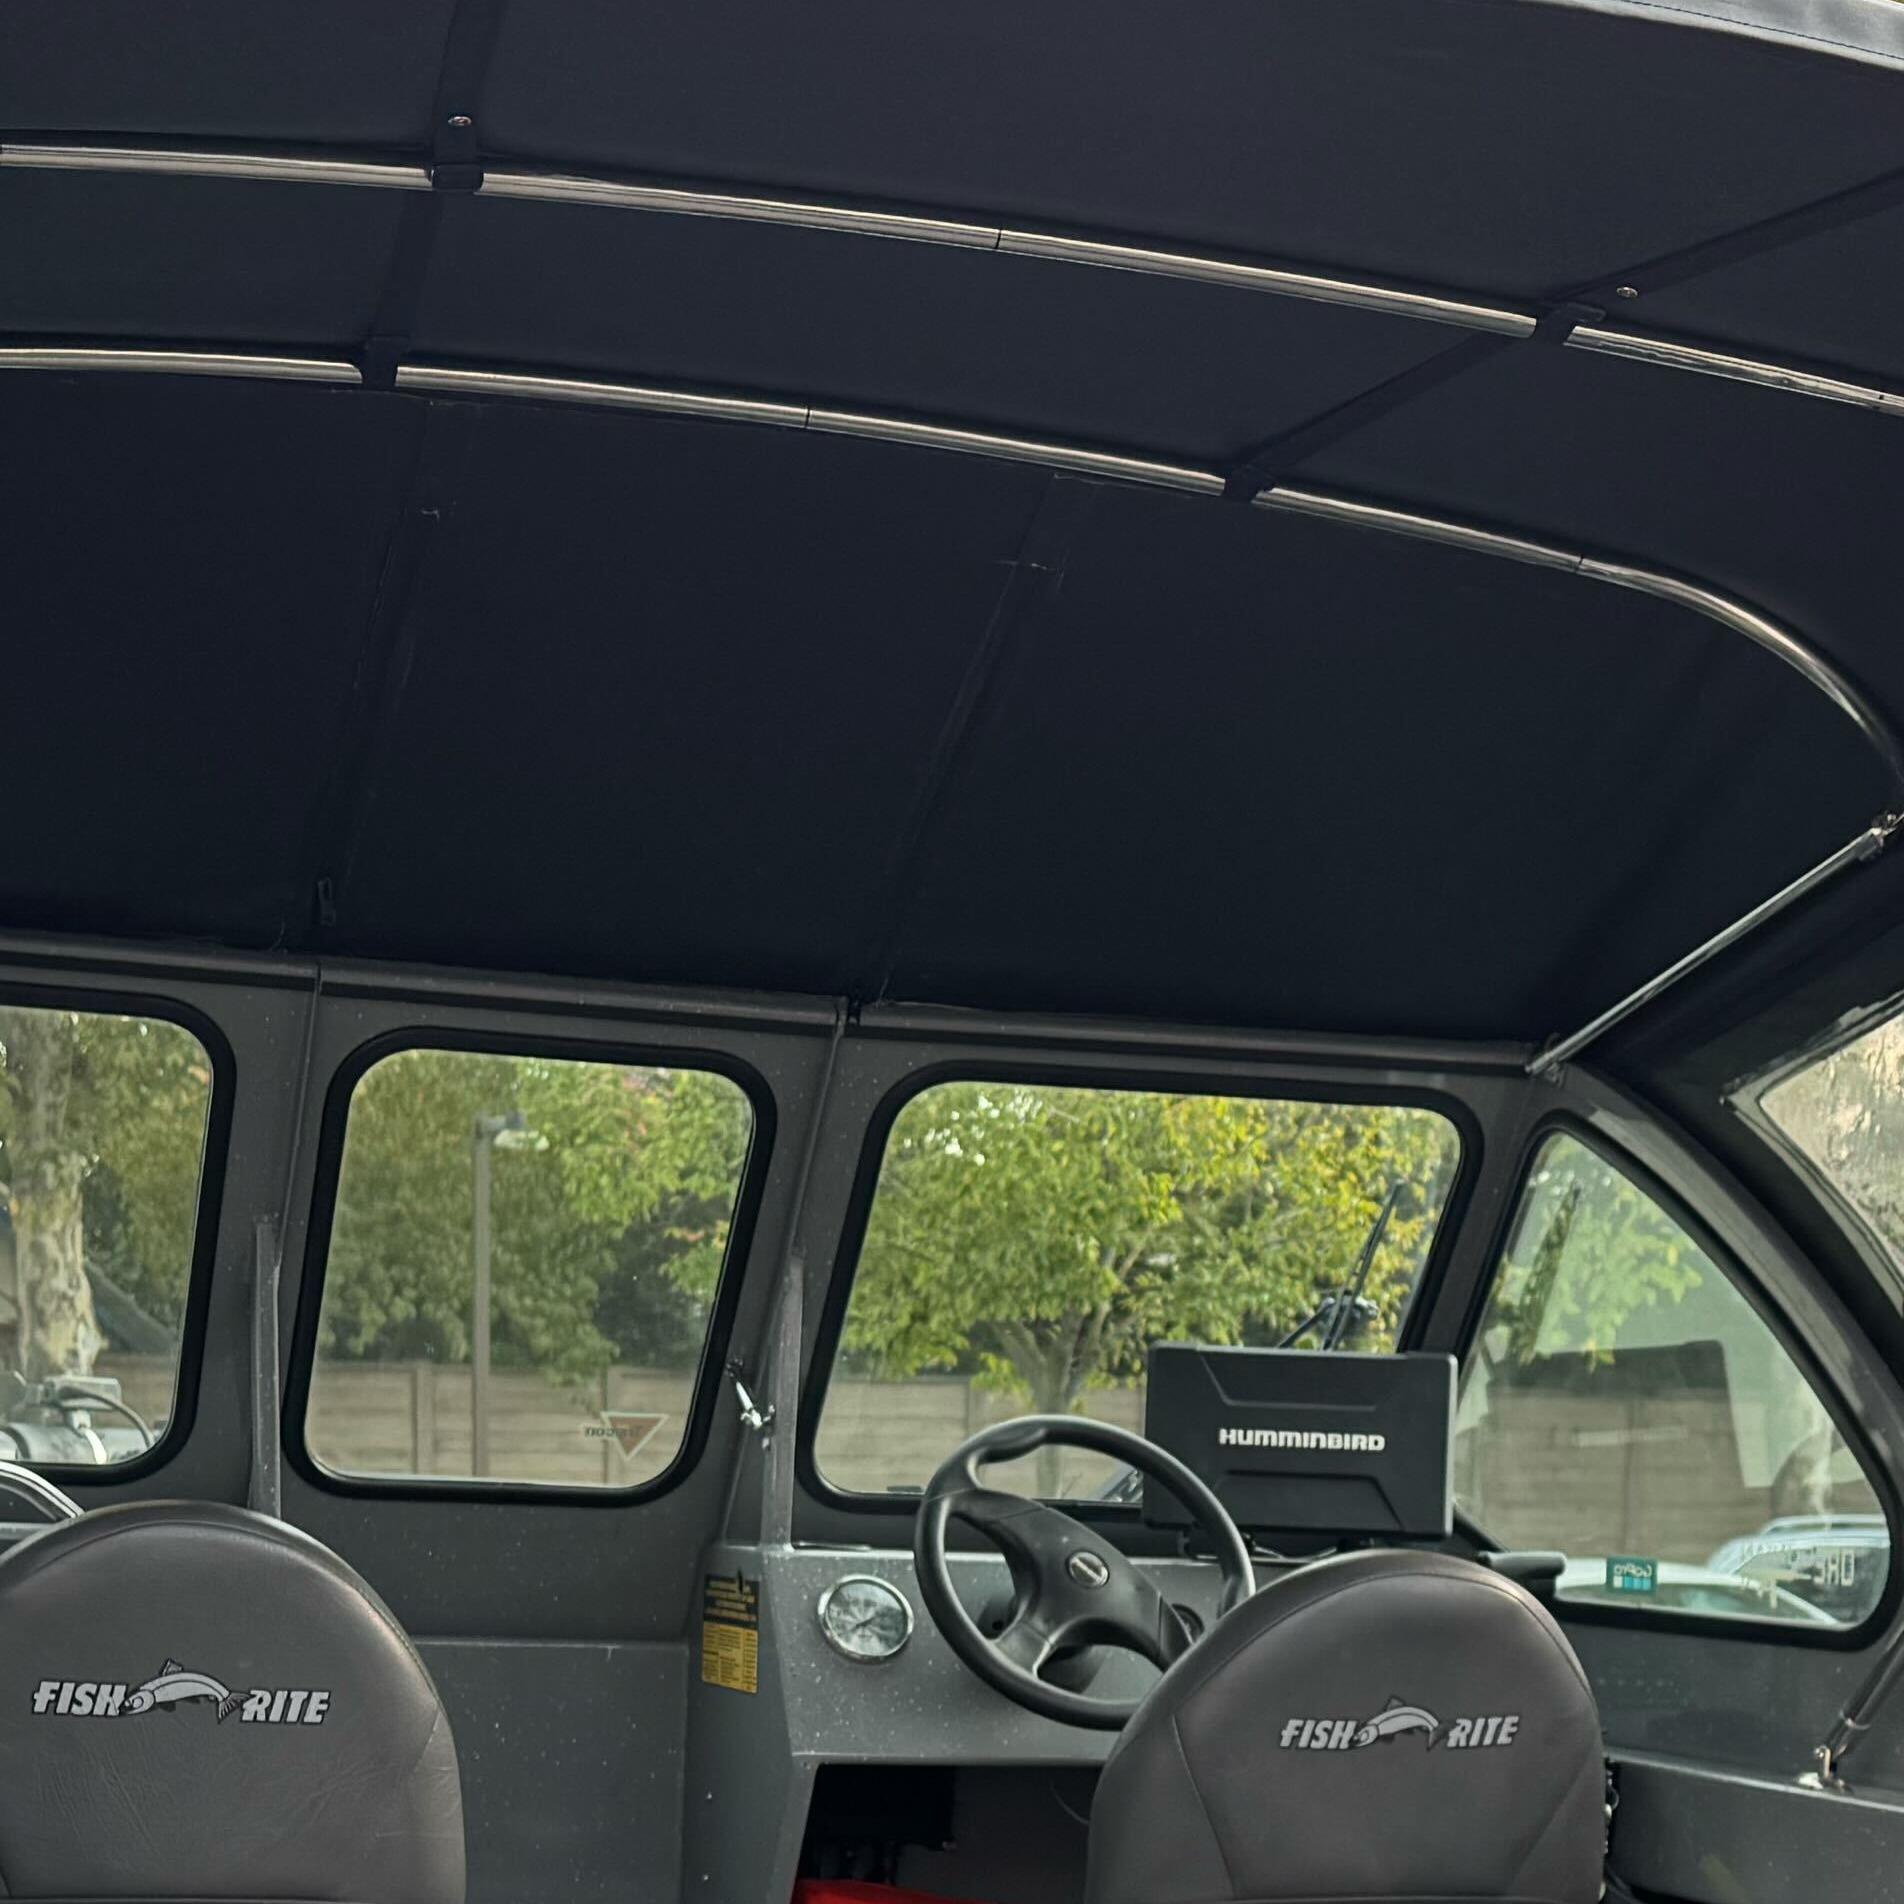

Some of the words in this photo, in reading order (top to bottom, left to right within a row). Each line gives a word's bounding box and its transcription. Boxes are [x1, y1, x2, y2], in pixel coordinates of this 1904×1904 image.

[1219, 1428, 1386, 1451] HUMMINBIRD
[32, 1680, 127, 1717] FISH
[240, 1689, 331, 1724] RITE
[1279, 1718, 1358, 1750] FISH
[1447, 1715, 1520, 1748] RITE
